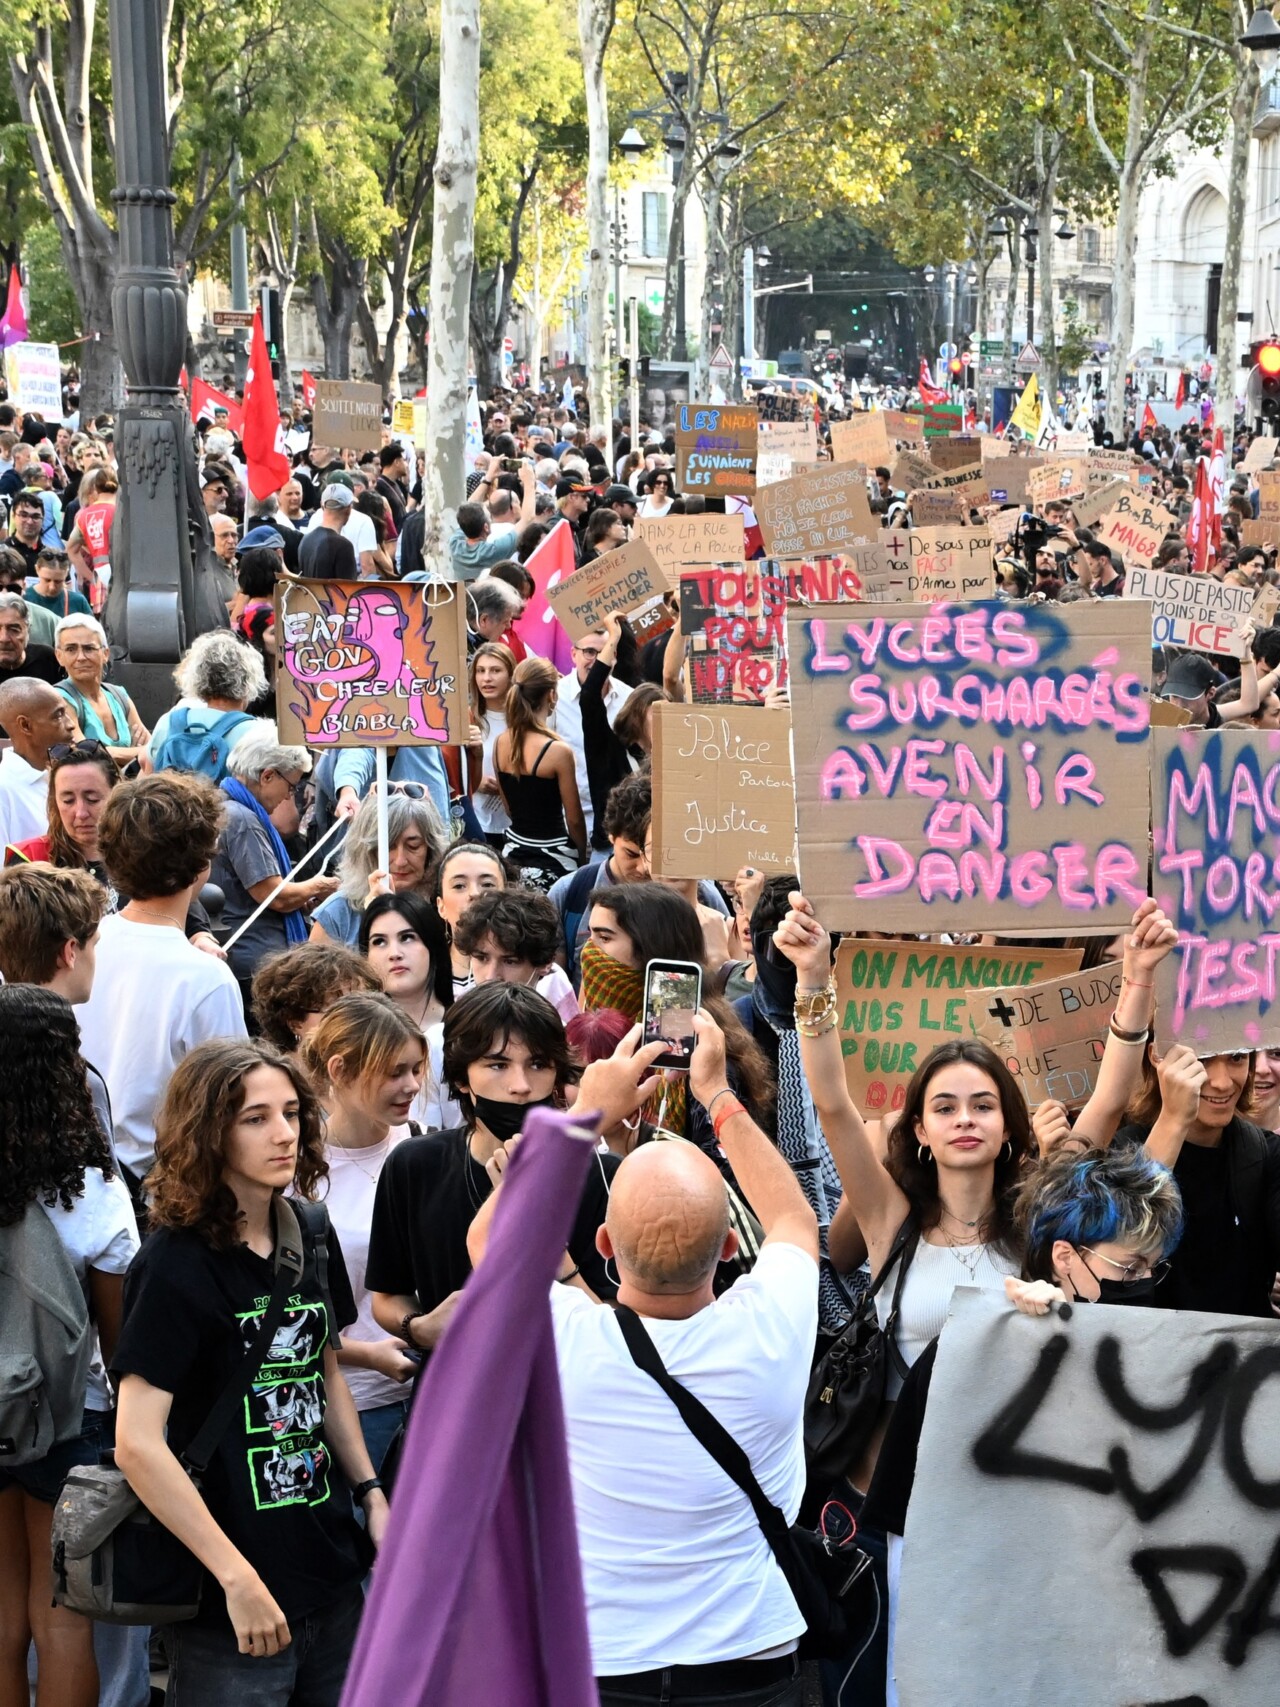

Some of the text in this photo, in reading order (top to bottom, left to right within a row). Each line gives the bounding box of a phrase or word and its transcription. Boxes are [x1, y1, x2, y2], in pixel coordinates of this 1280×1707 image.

[757, 393, 798, 412] POLICE
[680, 405, 720, 432] LES
[685, 469, 711, 485] LES
[943, 468, 983, 487] JEUNESSE
[639, 523, 728, 540] DANS LA RUE
[656, 540, 744, 557] AR LA POLICE
[908, 535, 930, 557] De
[855, 551, 878, 572] LES
[886, 559, 909, 571] nos
[550, 572, 585, 599] SERVICES
[908, 576, 956, 591] D'Armes
[1130, 570, 1252, 614] PLUS DE PASTIS
[584, 579, 654, 627] EN DANGER
[1152, 600, 1216, 624] MOINS DE
[284, 612, 345, 643] EAT
[639, 608, 662, 629] DES
[809, 602, 1041, 672] LYCÉES
[1153, 616, 1234, 653] OLICE
[294, 646, 362, 677] GOV
[316, 675, 456, 701] CHIE LEUR
[847, 648, 1150, 733] SURCHARGÉS
[322, 713, 419, 735] BLABLA
[678, 713, 774, 764] Police
[738, 770, 794, 788] Partou
[684, 800, 770, 845] Justice
[927, 800, 1004, 850] EN
[855, 835, 1152, 910] DANGER
[851, 949, 1044, 990] ON MANQUE
[1011, 975, 1123, 1027] DE BUDG
[841, 998, 905, 1035] NOS
[1005, 1048, 1062, 1075] QUE
[254, 1295, 272, 1309] RO
